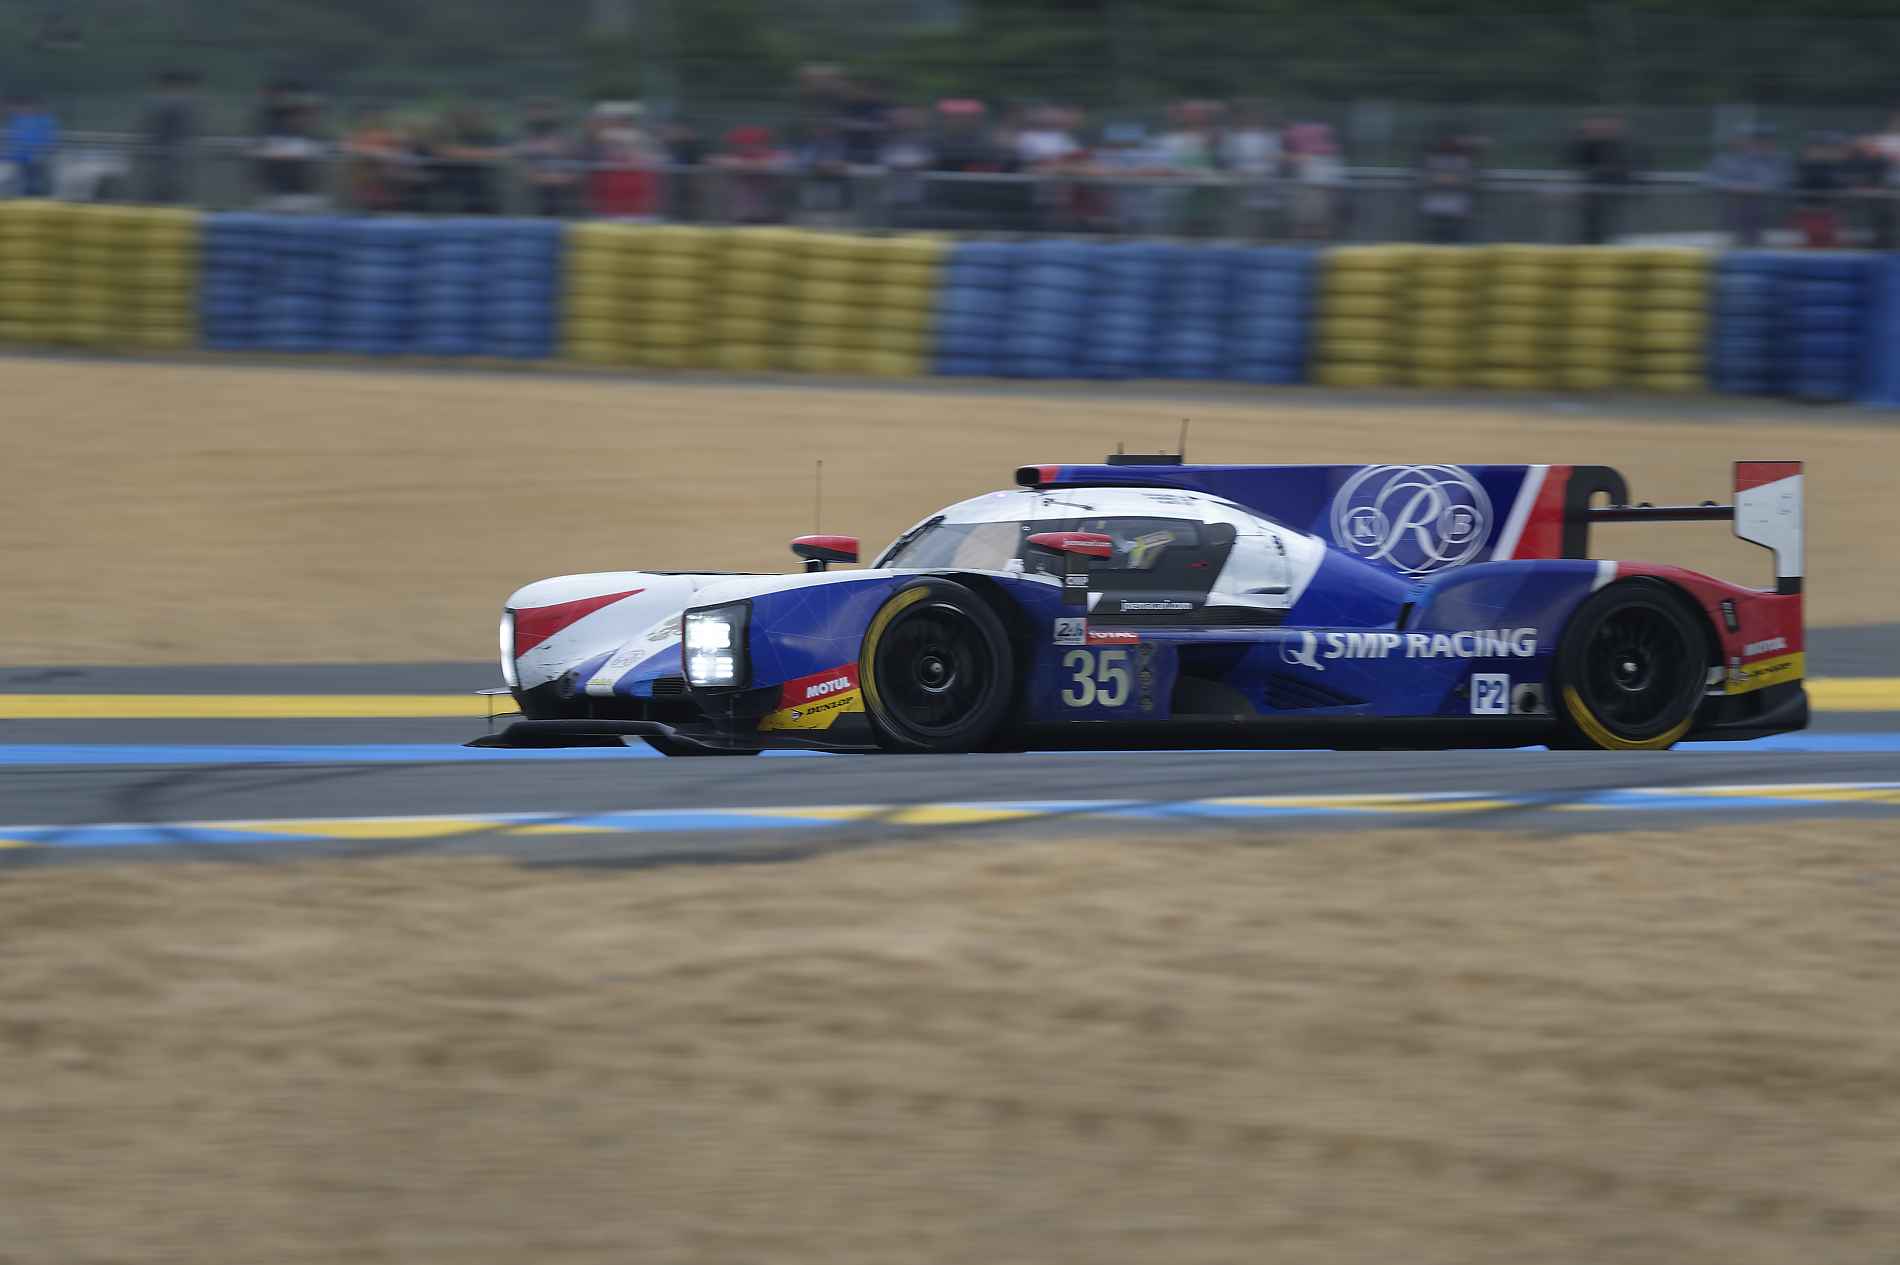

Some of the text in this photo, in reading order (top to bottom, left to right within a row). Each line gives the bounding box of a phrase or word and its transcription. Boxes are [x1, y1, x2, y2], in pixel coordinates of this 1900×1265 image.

[1324, 628, 1537, 659] SMP RACING
[806, 677, 851, 698] MOTUL
[1061, 649, 1130, 707] 35
[806, 696, 854, 716] DUNLOP
[1476, 679, 1505, 709] P2
